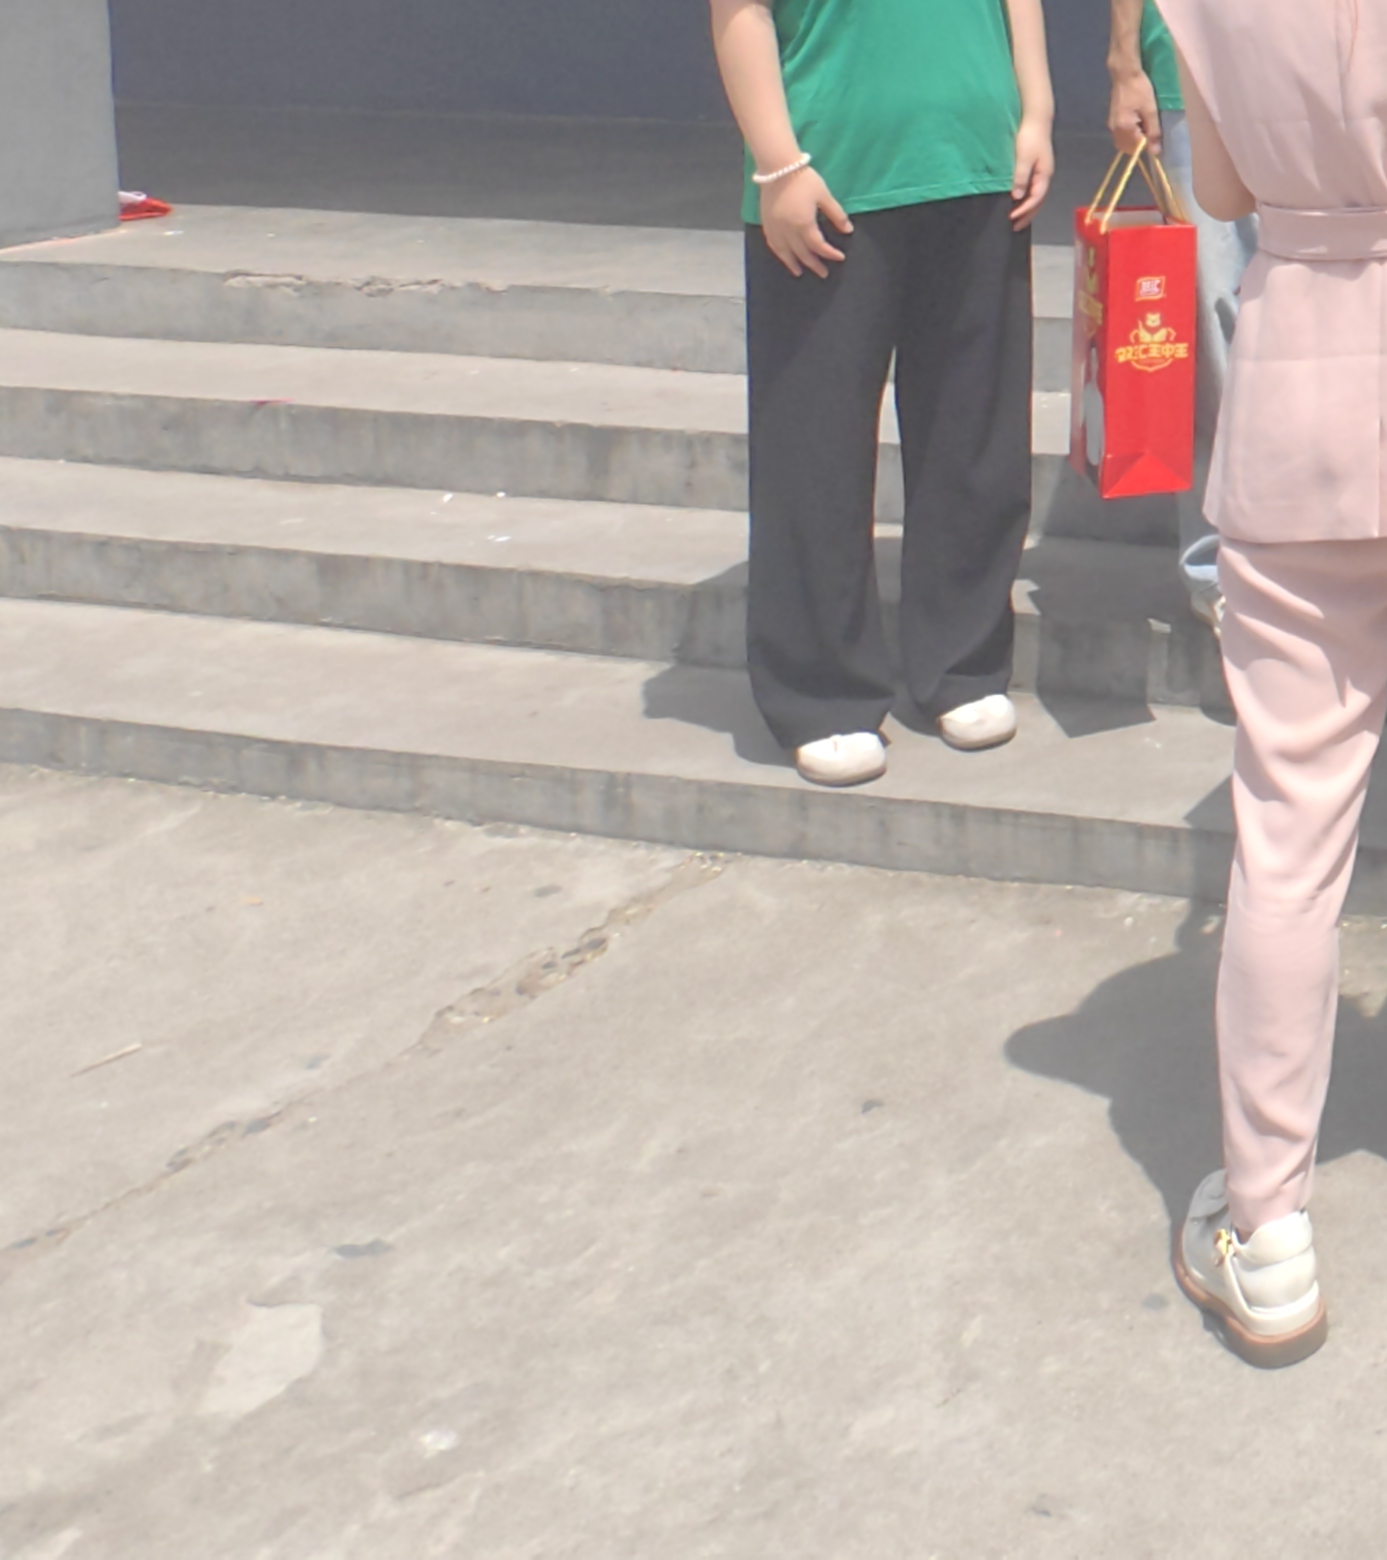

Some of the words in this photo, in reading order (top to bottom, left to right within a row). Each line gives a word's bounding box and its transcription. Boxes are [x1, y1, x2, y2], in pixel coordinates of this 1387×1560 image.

[1115, 342, 1189, 364] 双汇王中王
